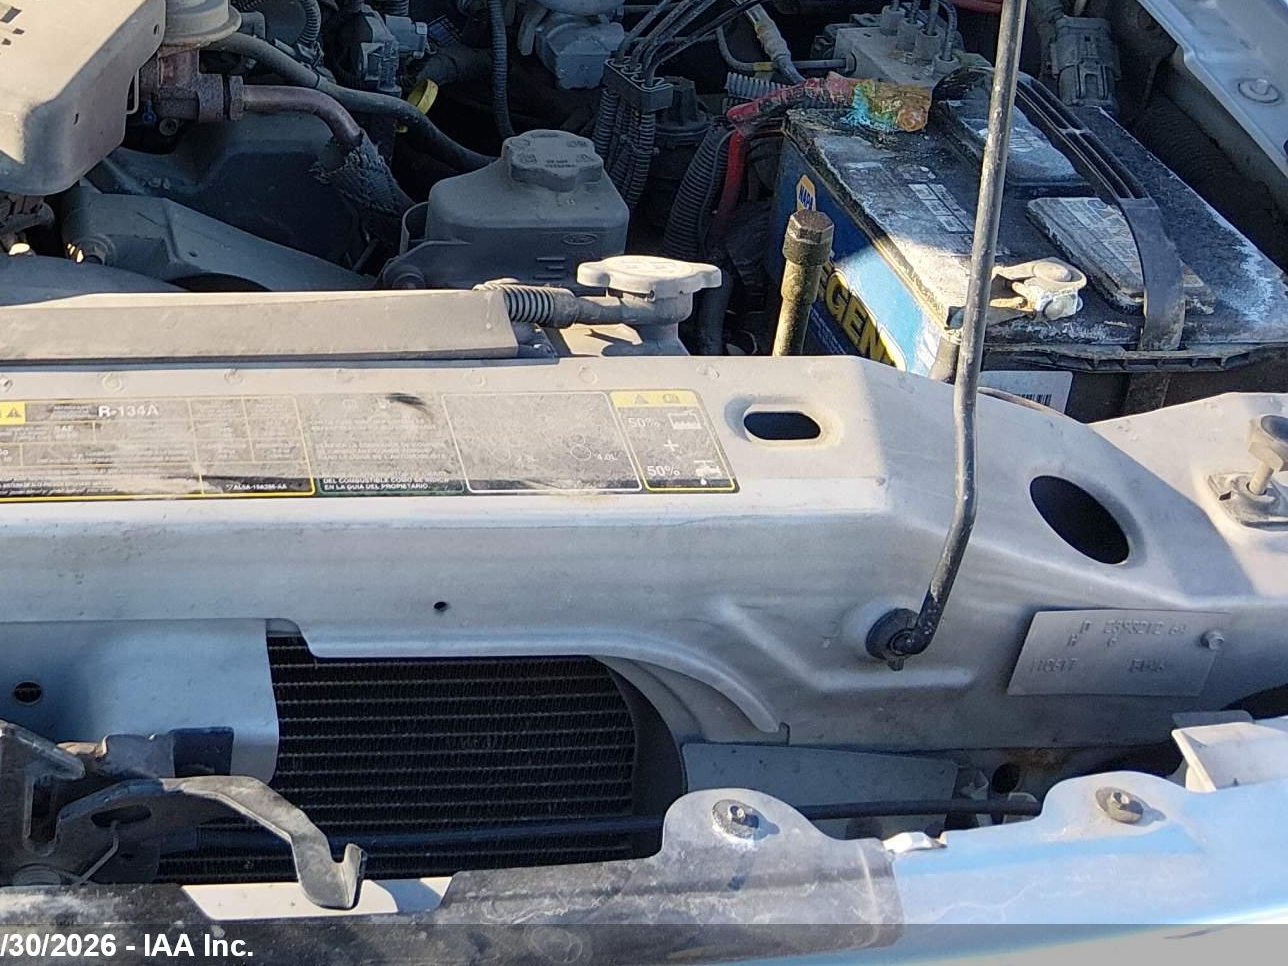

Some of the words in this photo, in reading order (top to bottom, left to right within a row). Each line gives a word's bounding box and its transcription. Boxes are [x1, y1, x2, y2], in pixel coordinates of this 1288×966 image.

[98, 404, 159, 418] R-134A
[627, 417, 661, 428] 50%
[647, 465, 681, 476] 50%
